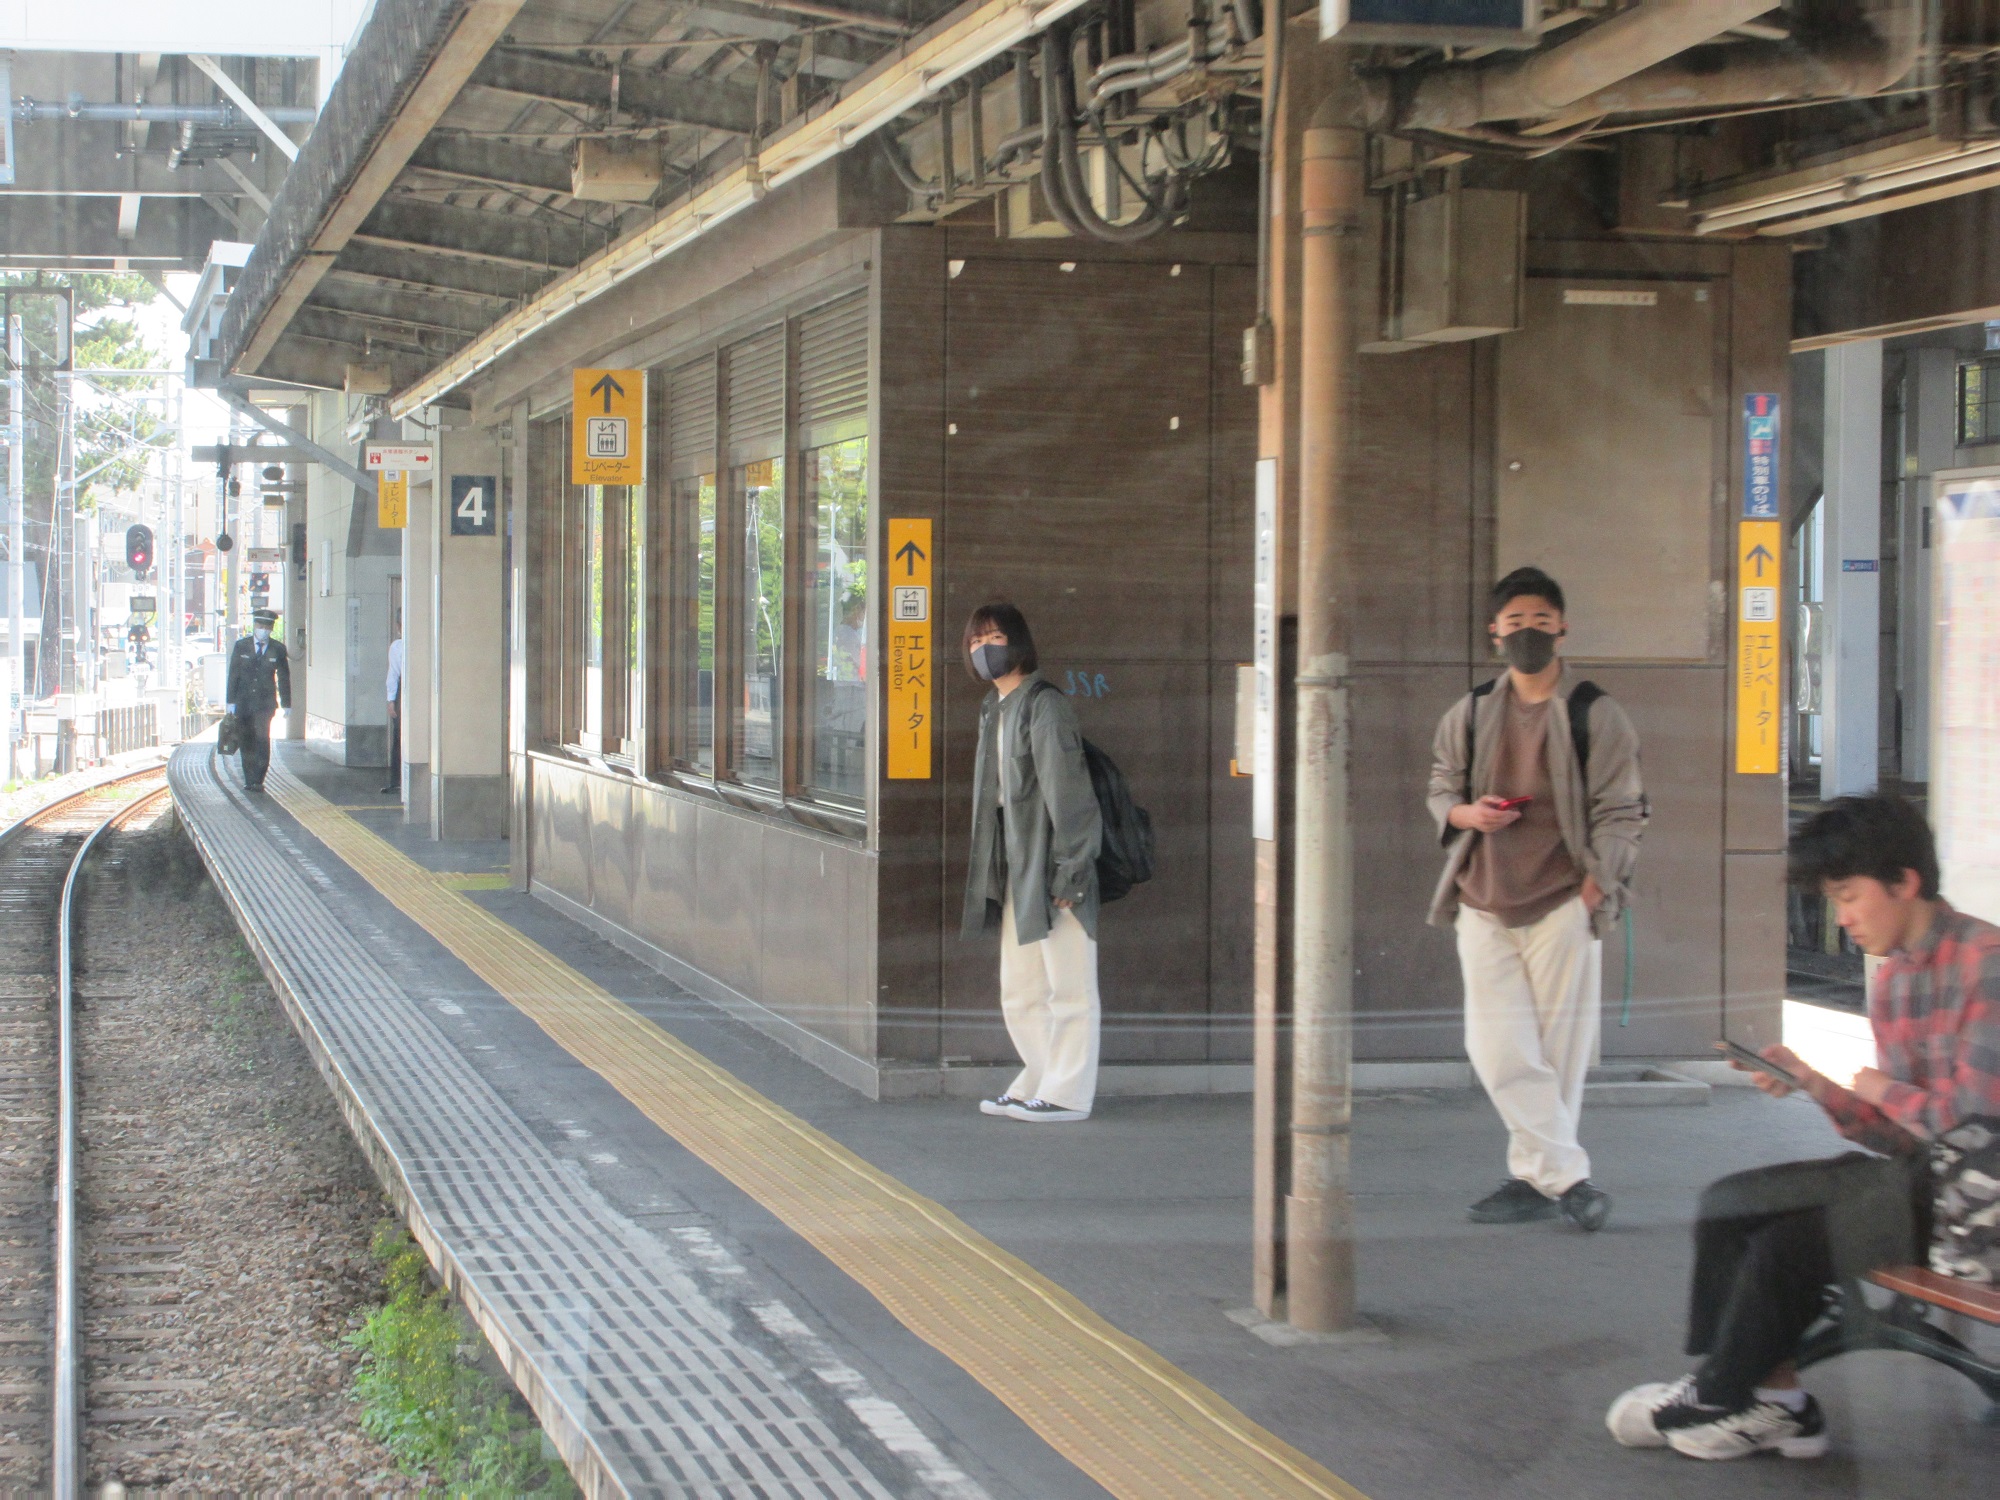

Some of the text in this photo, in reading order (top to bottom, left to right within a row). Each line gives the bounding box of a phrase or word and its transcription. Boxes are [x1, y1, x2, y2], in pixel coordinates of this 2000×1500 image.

[583, 461, 631, 473] エレベーター
[590, 474, 624, 482] Elevator
[390, 482, 400, 526] エレベーター
[457, 486, 487, 526] 4
[893, 635, 906, 692] Elevator
[907, 635, 926, 750] エレベーター
[1755, 635, 1775, 746] エレベーター
